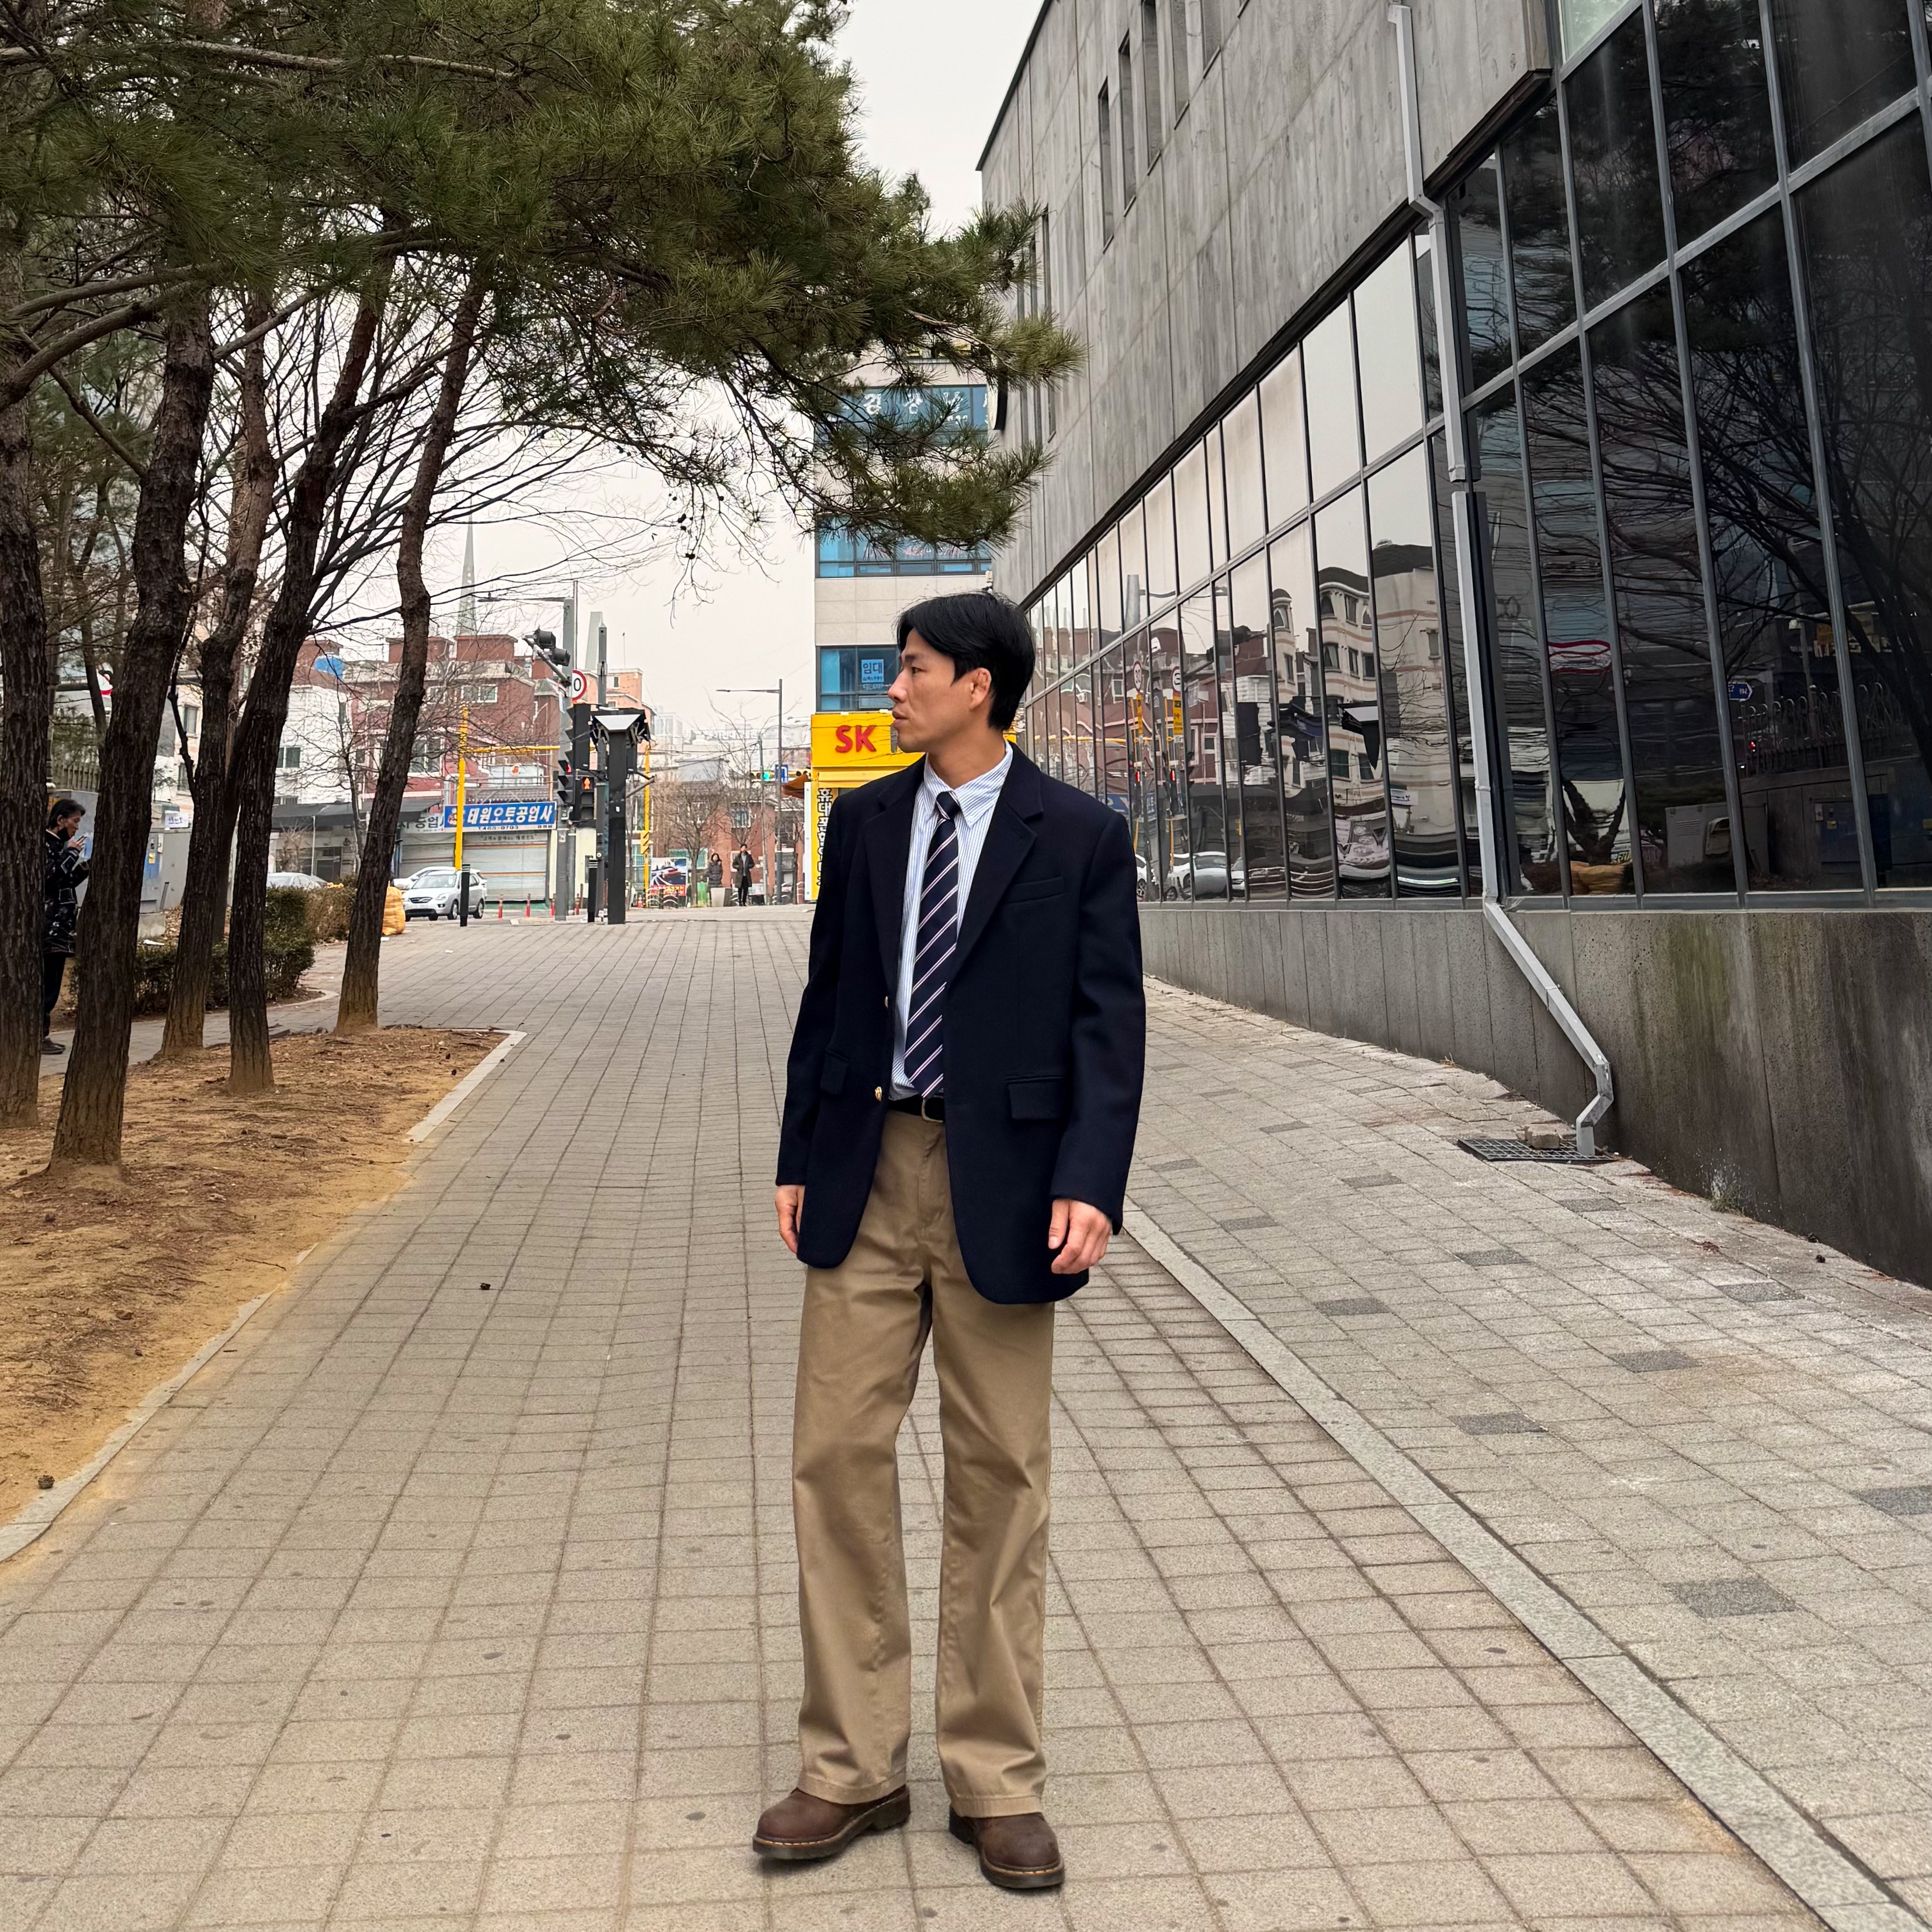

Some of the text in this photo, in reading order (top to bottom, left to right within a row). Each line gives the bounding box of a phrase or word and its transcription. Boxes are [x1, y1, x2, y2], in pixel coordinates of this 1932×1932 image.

[863, 662, 882, 674] 임대
[573, 678, 581, 692] 0
[835, 725, 877, 753] SK
[467, 805, 553, 825] 태원오토공업사
